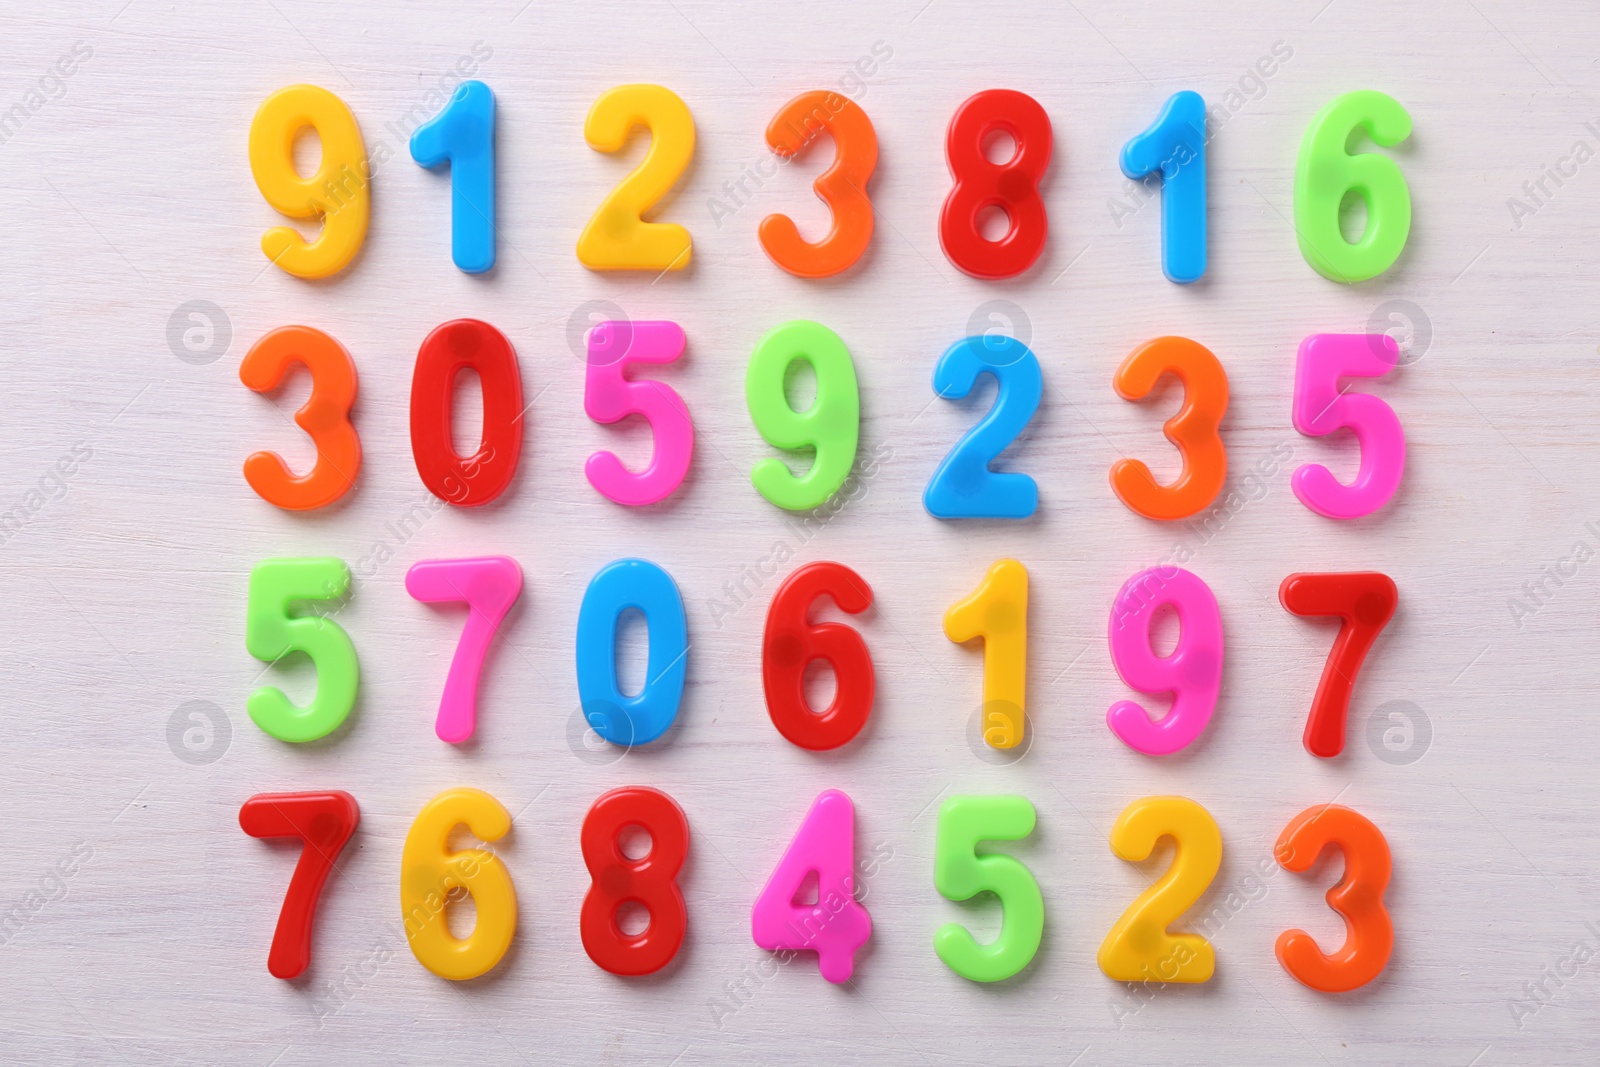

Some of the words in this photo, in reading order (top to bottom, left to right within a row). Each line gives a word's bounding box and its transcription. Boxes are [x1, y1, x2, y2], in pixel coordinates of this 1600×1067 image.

[249, 85, 371, 279] 9
[410, 81, 497, 274] 1
[576, 84, 697, 272] 2
[758, 90, 879, 279] 3
[940, 88, 1053, 280] 8
[1120, 90, 1208, 284] 1
[1295, 90, 1413, 283] 6
[240, 325, 362, 512] 3
[410, 319, 525, 507] 0
[585, 320, 695, 506] 5
[746, 320, 860, 512] 9
[923, 335, 1044, 519] 2
[1110, 336, 1230, 521] 3
[1291, 333, 1406, 520] 5
[246, 557, 360, 743] 5
[405, 556, 524, 744] 7
[576, 558, 688, 746] 0
[762, 561, 876, 753] 6
[943, 558, 1030, 750] 1
[1107, 566, 1225, 756] 9
[1279, 572, 1399, 758] 7
[239, 791, 360, 980] 7
[400, 787, 518, 981] 6
[580, 786, 691, 977] 8
[751, 790, 873, 984] 4
[934, 795, 1045, 983] 5
[1097, 795, 1224, 985] 2
[1274, 804, 1394, 994] 3
